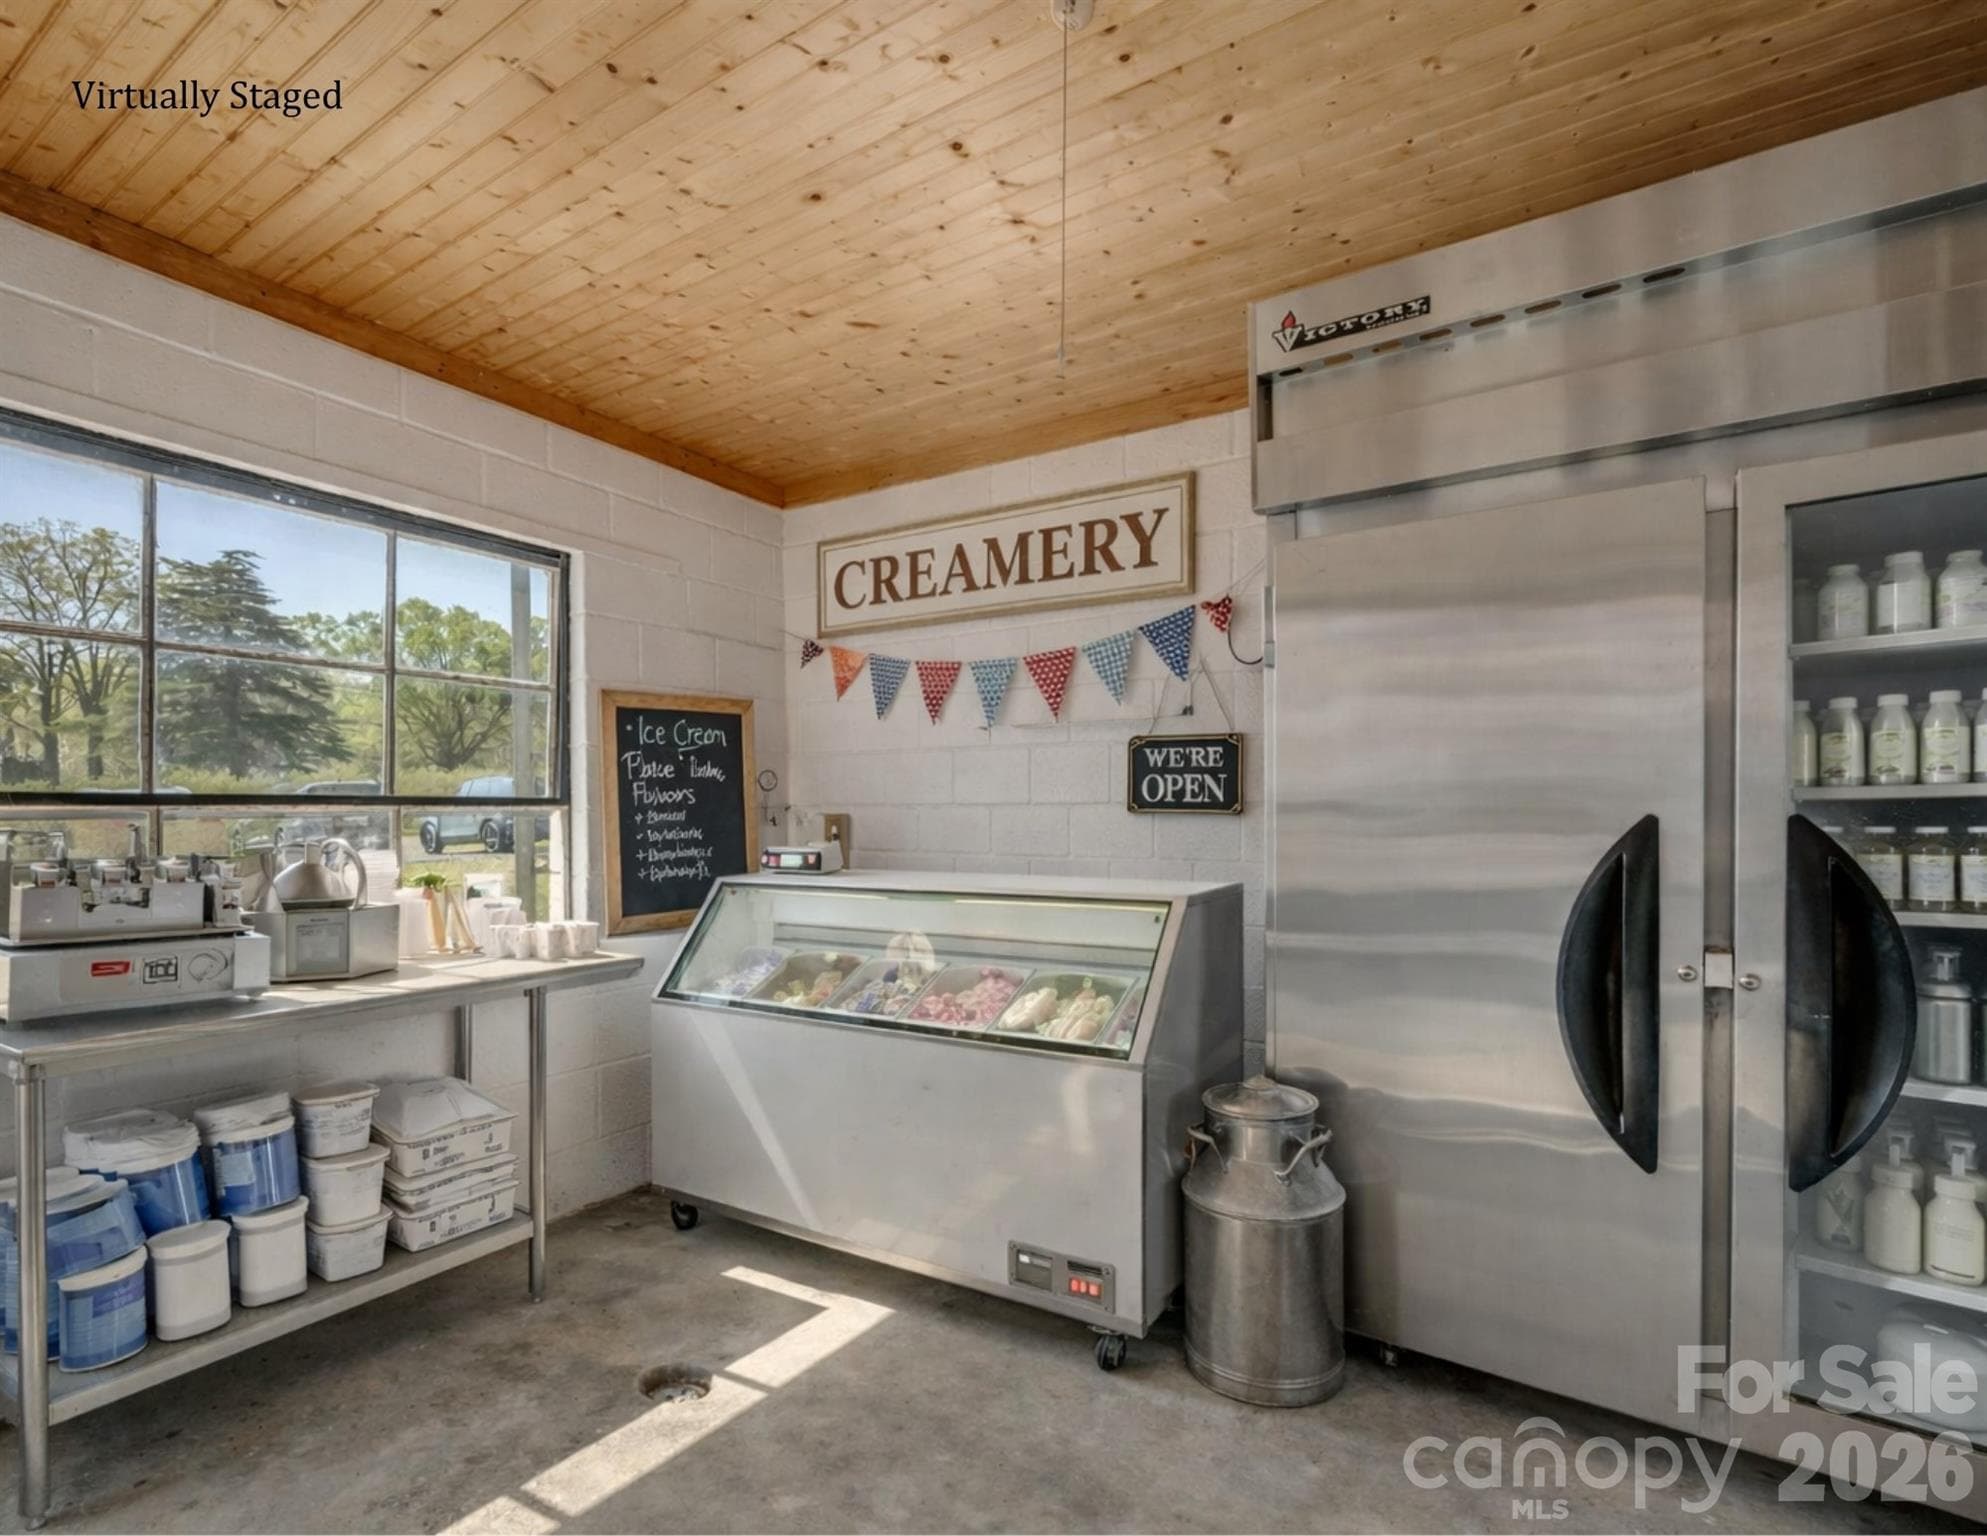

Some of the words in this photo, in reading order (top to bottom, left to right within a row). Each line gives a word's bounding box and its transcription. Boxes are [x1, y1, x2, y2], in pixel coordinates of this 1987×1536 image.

[1272, 298, 1427, 352] VICTORY
[833, 507, 1170, 611] CREAMERY
[638, 715, 667, 745] Ice
[1143, 746, 1225, 768] WE'RE
[1141, 773, 1228, 803] OPEN
